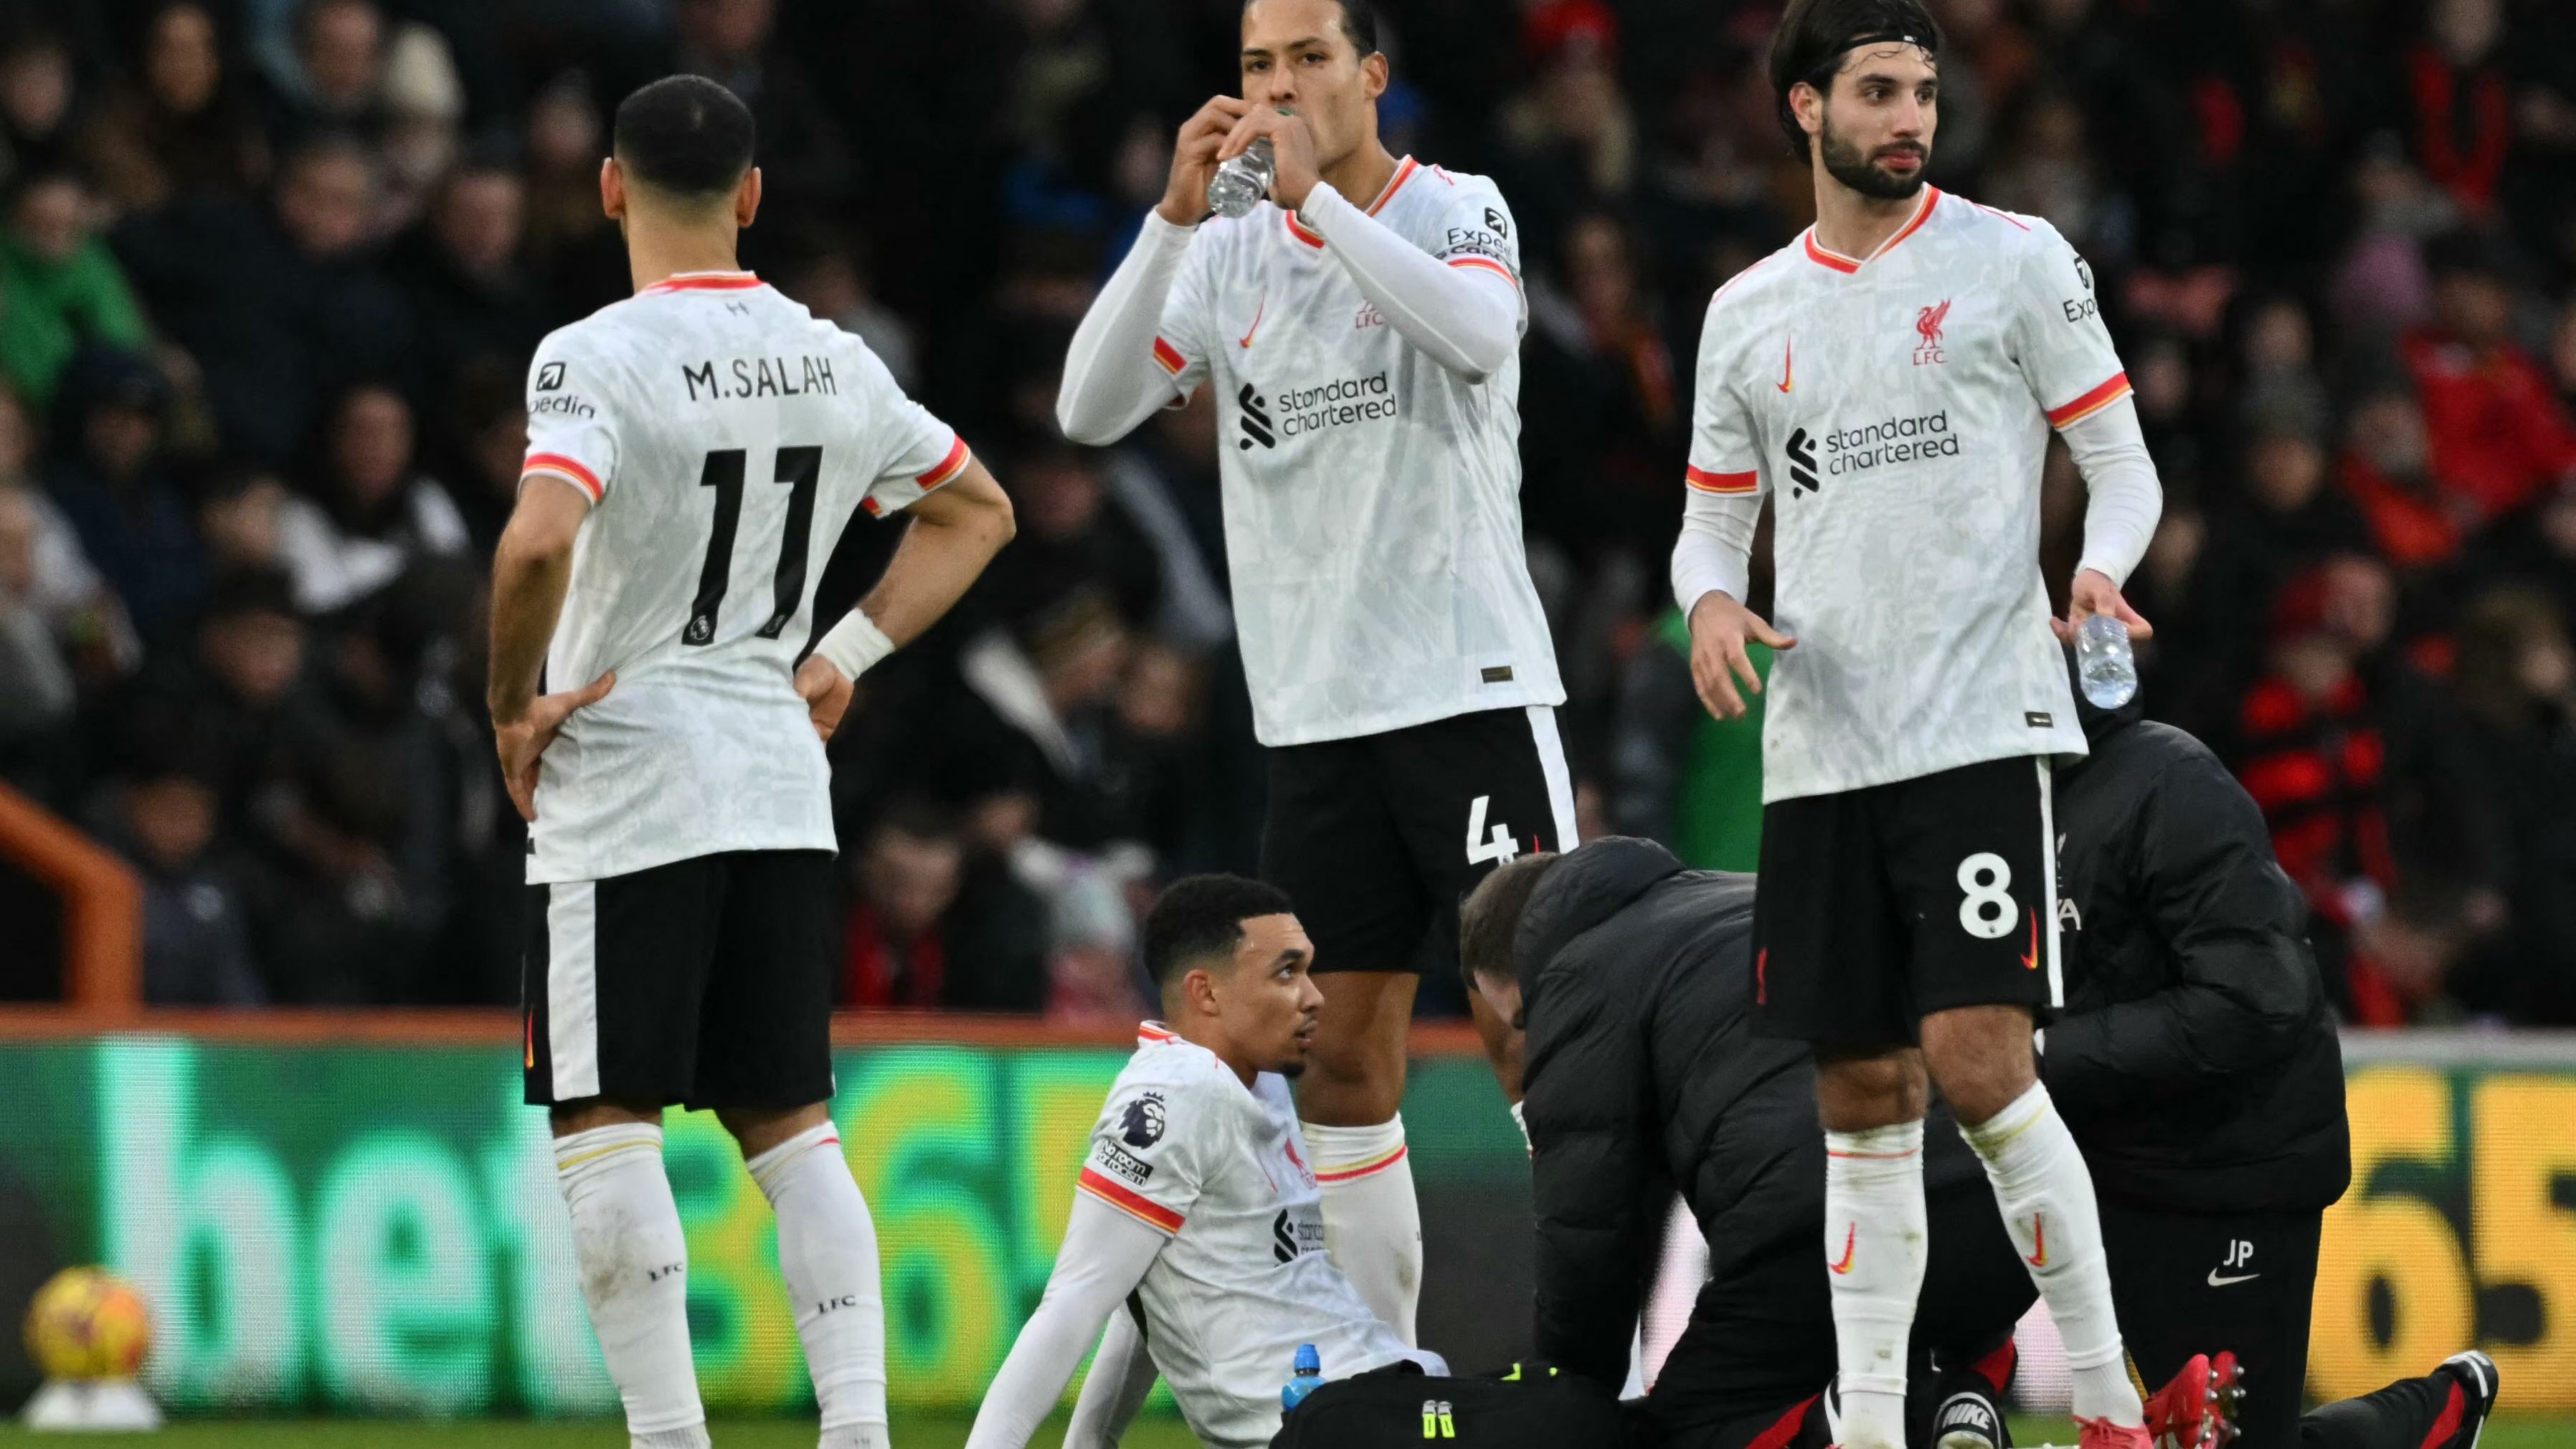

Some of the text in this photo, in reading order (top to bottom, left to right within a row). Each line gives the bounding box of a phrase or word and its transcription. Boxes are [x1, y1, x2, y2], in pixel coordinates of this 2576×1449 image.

[1447, 227, 1511, 260] Expe
[2063, 298, 2098, 323] Exp
[1913, 350, 1948, 366] LFC
[682, 355, 838, 402] M.SALAH
[1279, 371, 1388, 413] standard
[1283, 394, 1397, 436] chartered
[1826, 409, 1948, 453] standard
[1829, 433, 1959, 475] chartered
[681, 446, 823, 647] 11
[1467, 795, 1519, 867] 4
[1957, 852, 2019, 939] 8
[1107, 1159, 1147, 1187] racism
[1114, 1150, 1146, 1175] room
[2223, 1239, 2253, 1268] JP
[648, 1262, 684, 1282] LFC
[818, 1294, 857, 1314] LFC
[1941, 1403, 1991, 1430] NIKE
